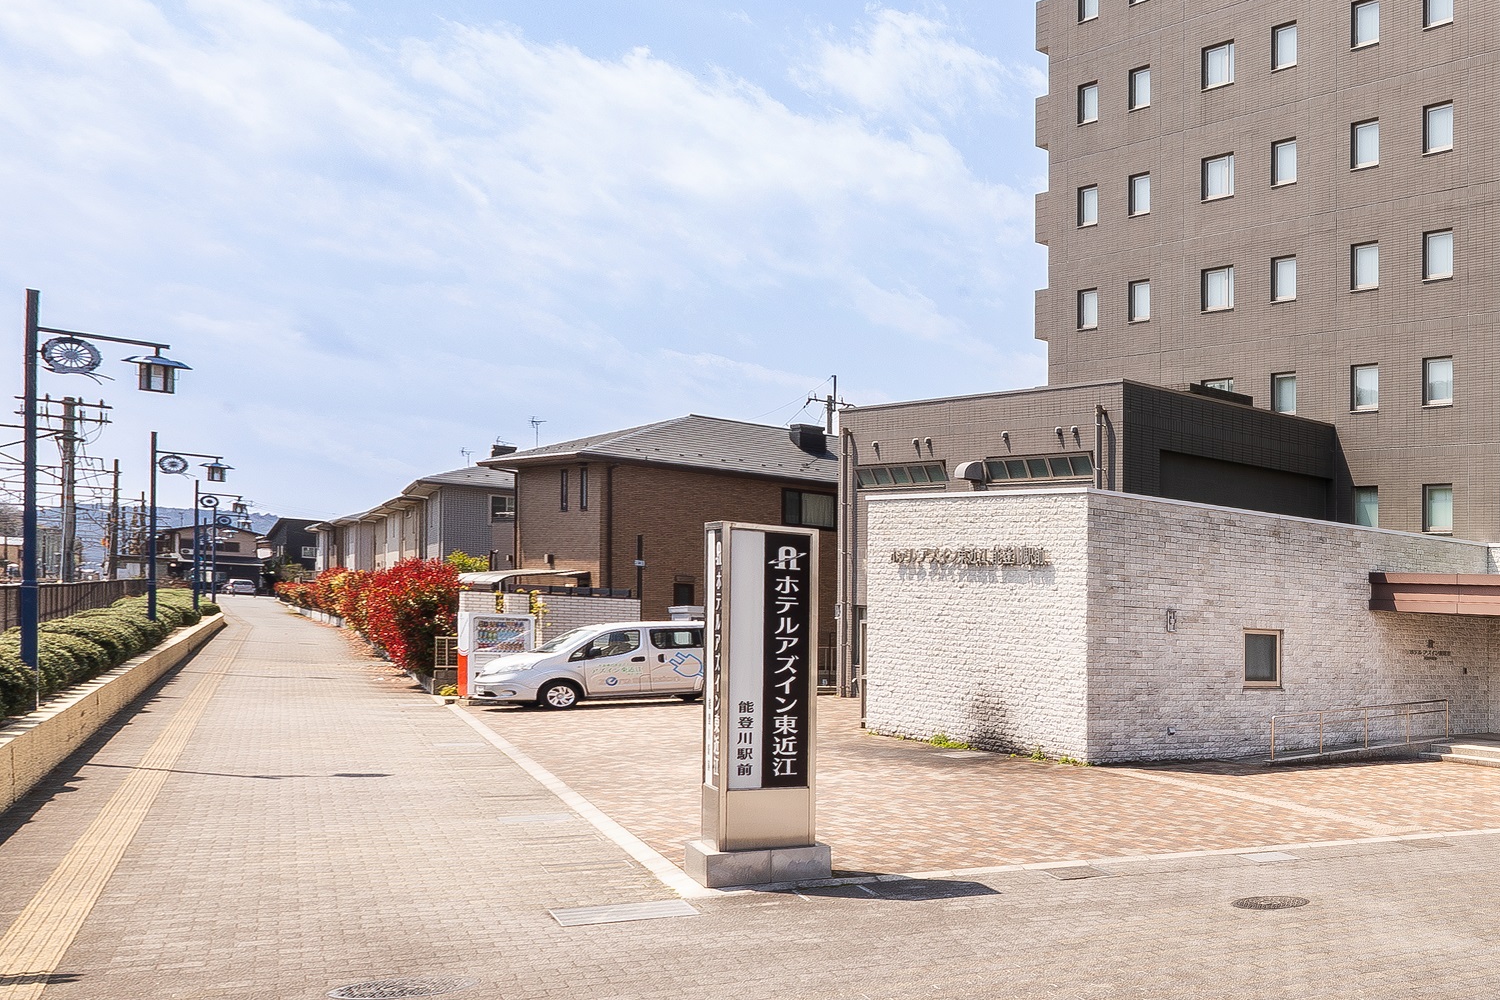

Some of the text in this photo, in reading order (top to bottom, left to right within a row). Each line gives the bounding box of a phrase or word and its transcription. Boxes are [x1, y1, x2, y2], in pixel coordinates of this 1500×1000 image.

[736, 700, 755, 777] 能登川駅前
[772, 575, 800, 777] ホテルアズイン東近江
